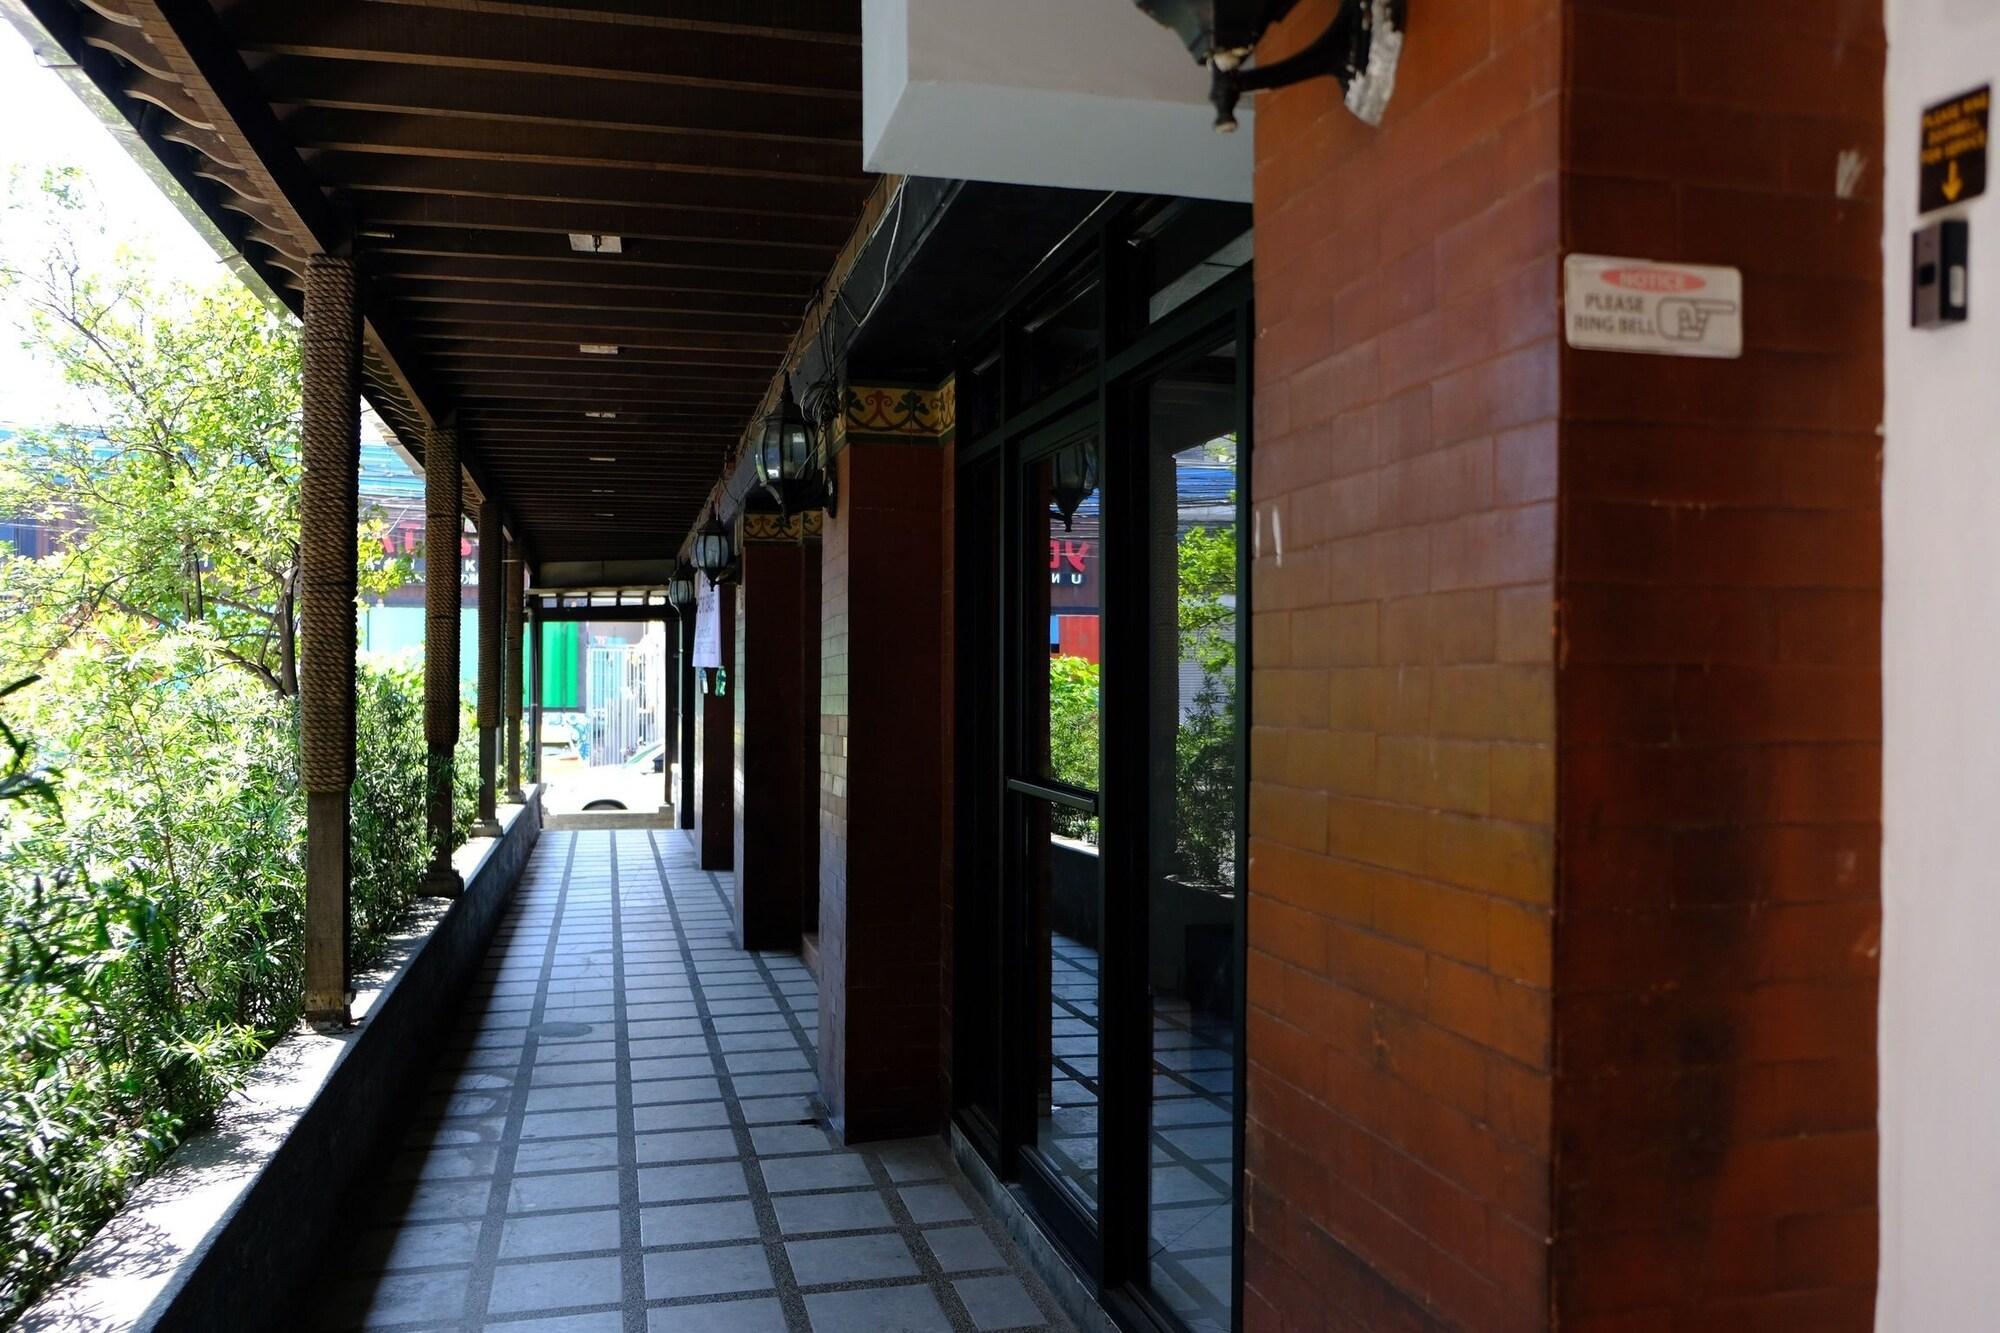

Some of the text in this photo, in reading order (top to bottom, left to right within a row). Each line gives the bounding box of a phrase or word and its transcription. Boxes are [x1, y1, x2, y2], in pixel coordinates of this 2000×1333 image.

[1585, 293, 1644, 313] PLEASE
[1574, 314, 1656, 336] RING BELL
